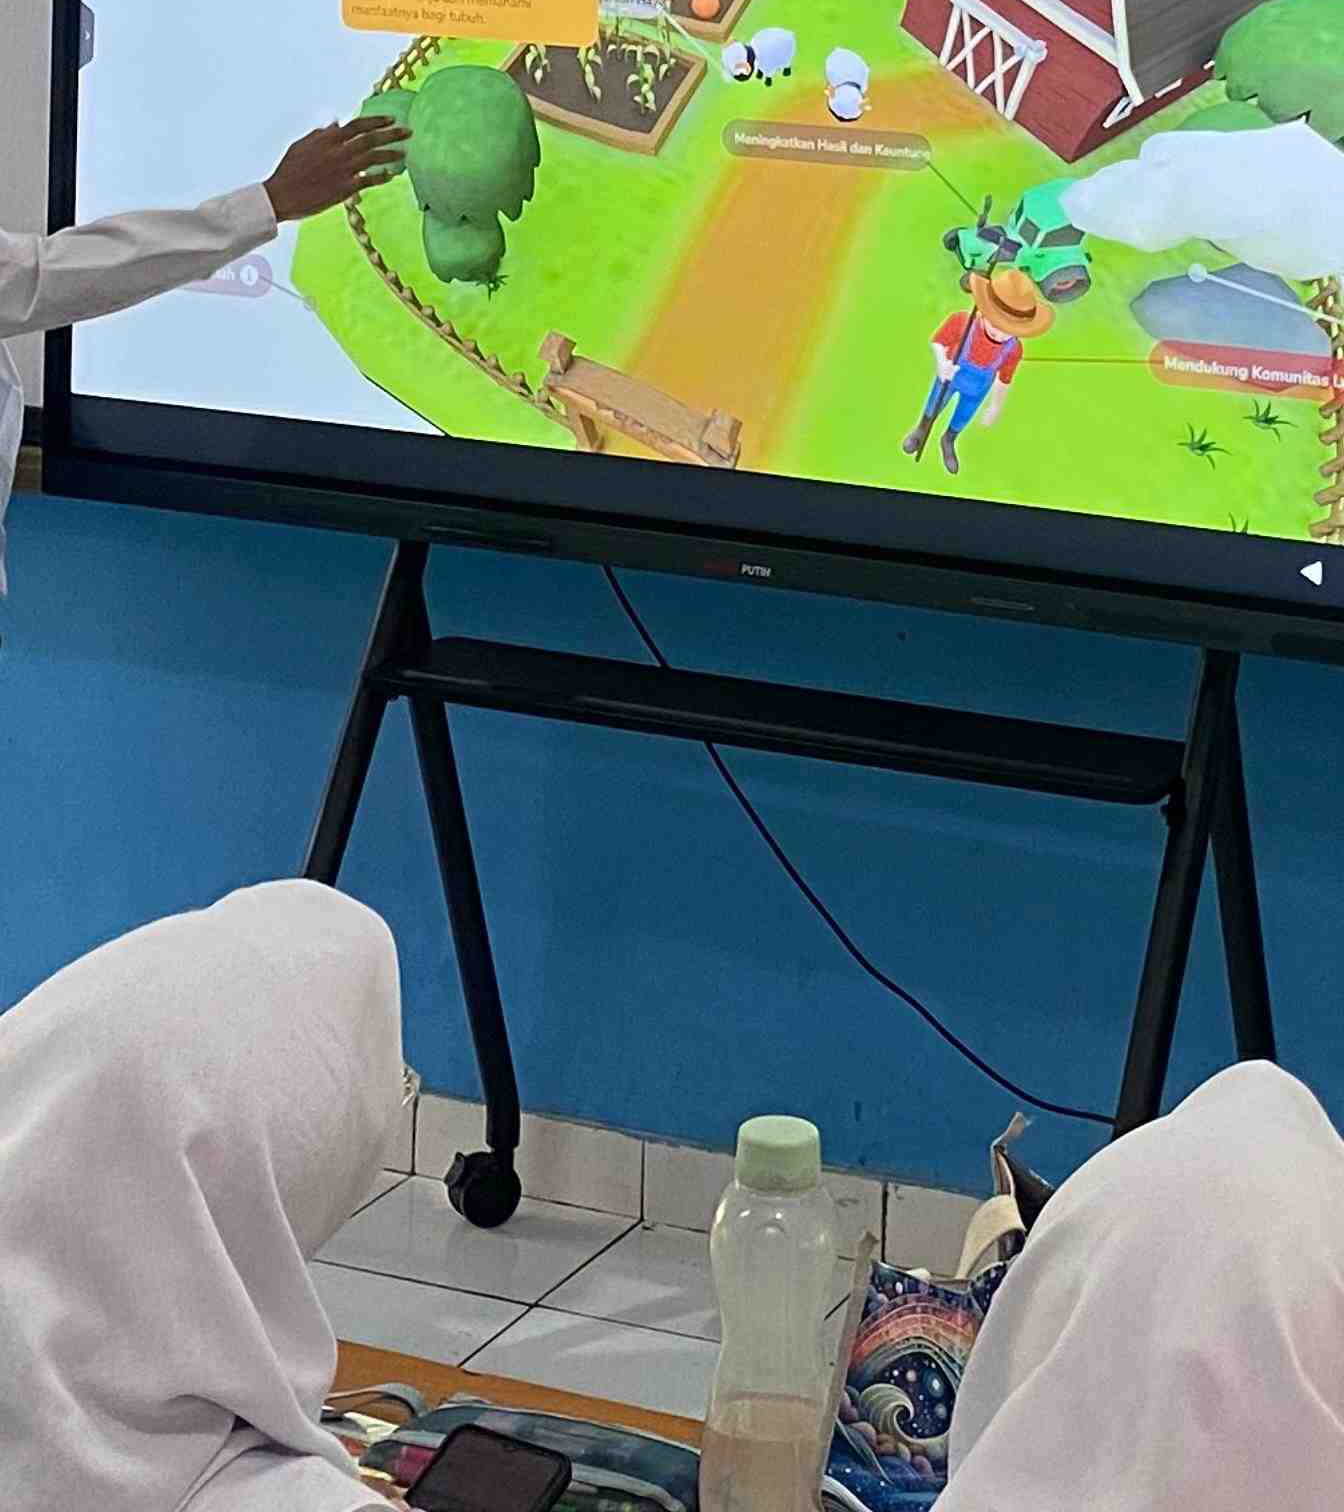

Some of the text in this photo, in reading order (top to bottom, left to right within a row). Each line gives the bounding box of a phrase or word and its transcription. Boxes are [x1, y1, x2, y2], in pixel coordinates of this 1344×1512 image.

[421, 7, 447, 23] bagi
[817, 138, 847, 153] Hasil
[849, 141, 872, 155] dan
[1163, 354, 1249, 380] Mendukung
[1251, 364, 1329, 388] Komunitas
[741, 563, 772, 577] PUTIH
